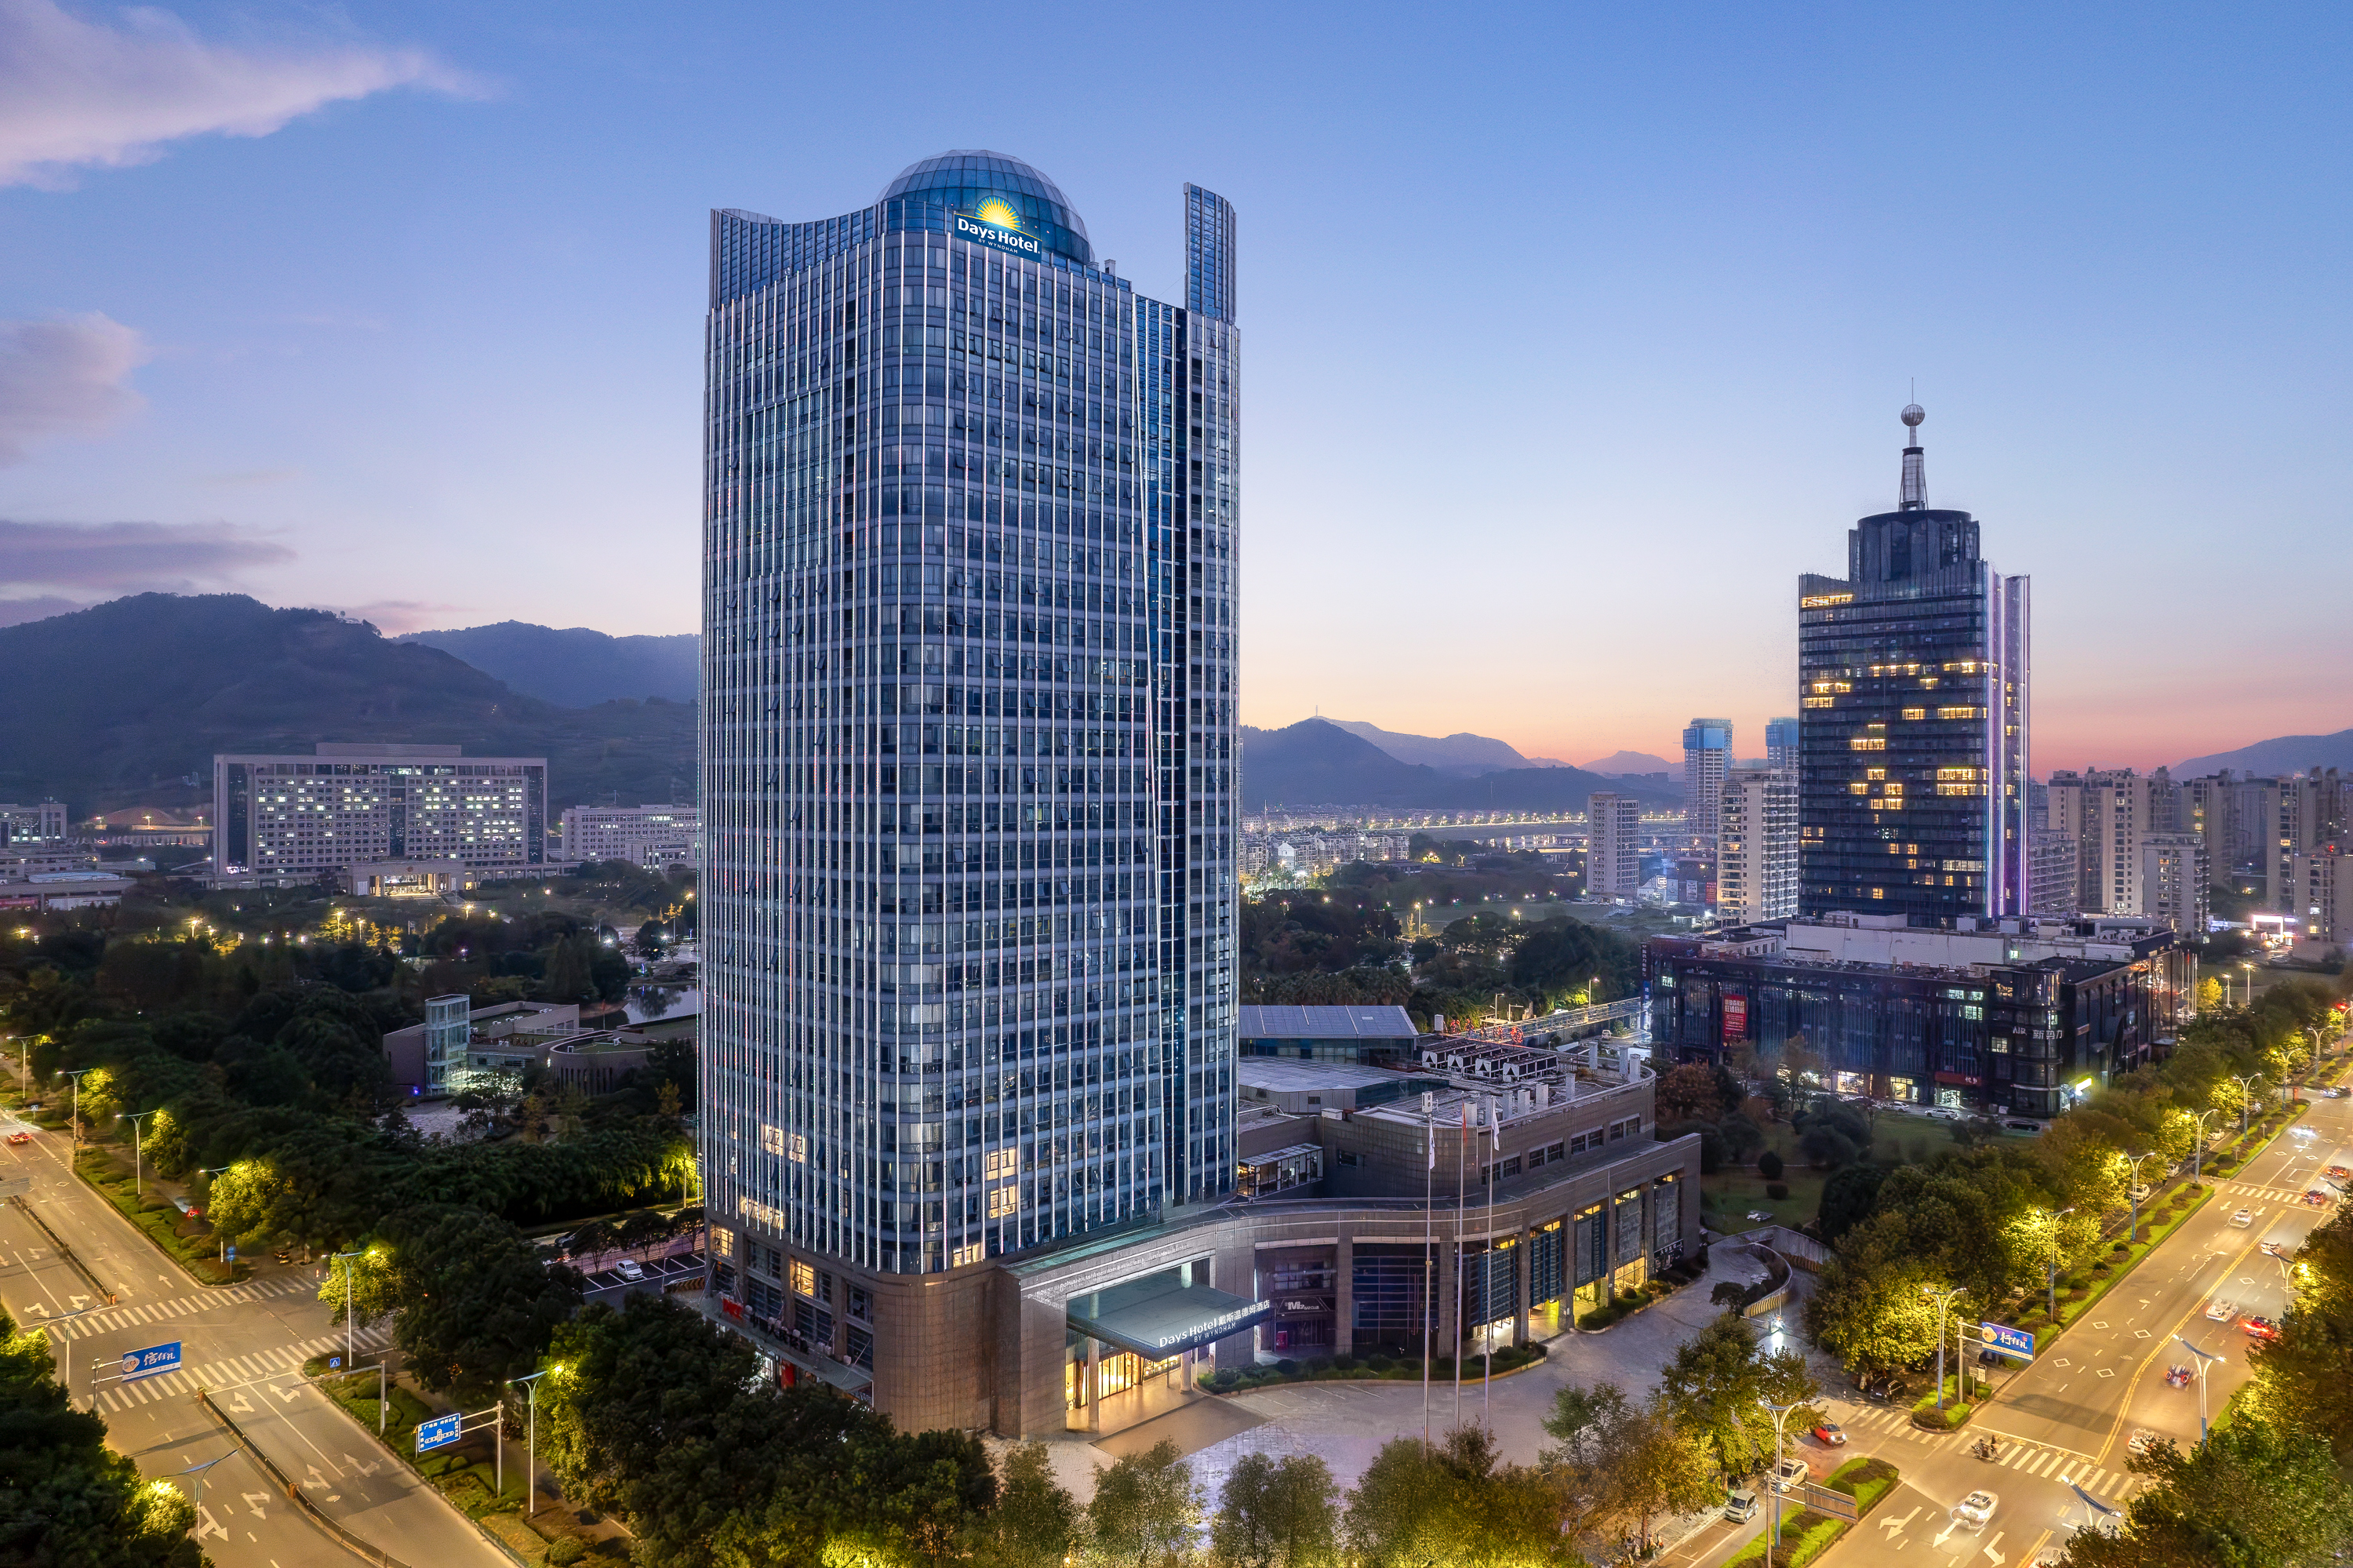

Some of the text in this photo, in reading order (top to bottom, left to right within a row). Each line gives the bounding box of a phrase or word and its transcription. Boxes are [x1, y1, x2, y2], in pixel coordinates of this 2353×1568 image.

[958, 218, 1038, 253] Days Hotel
[988, 242, 1018, 254] WYNDHAM
[1159, 1300, 1270, 1348] Days Hotel 戴斯温德姆酒店
[1194, 1322, 1236, 1343] BY WYNDHAM
